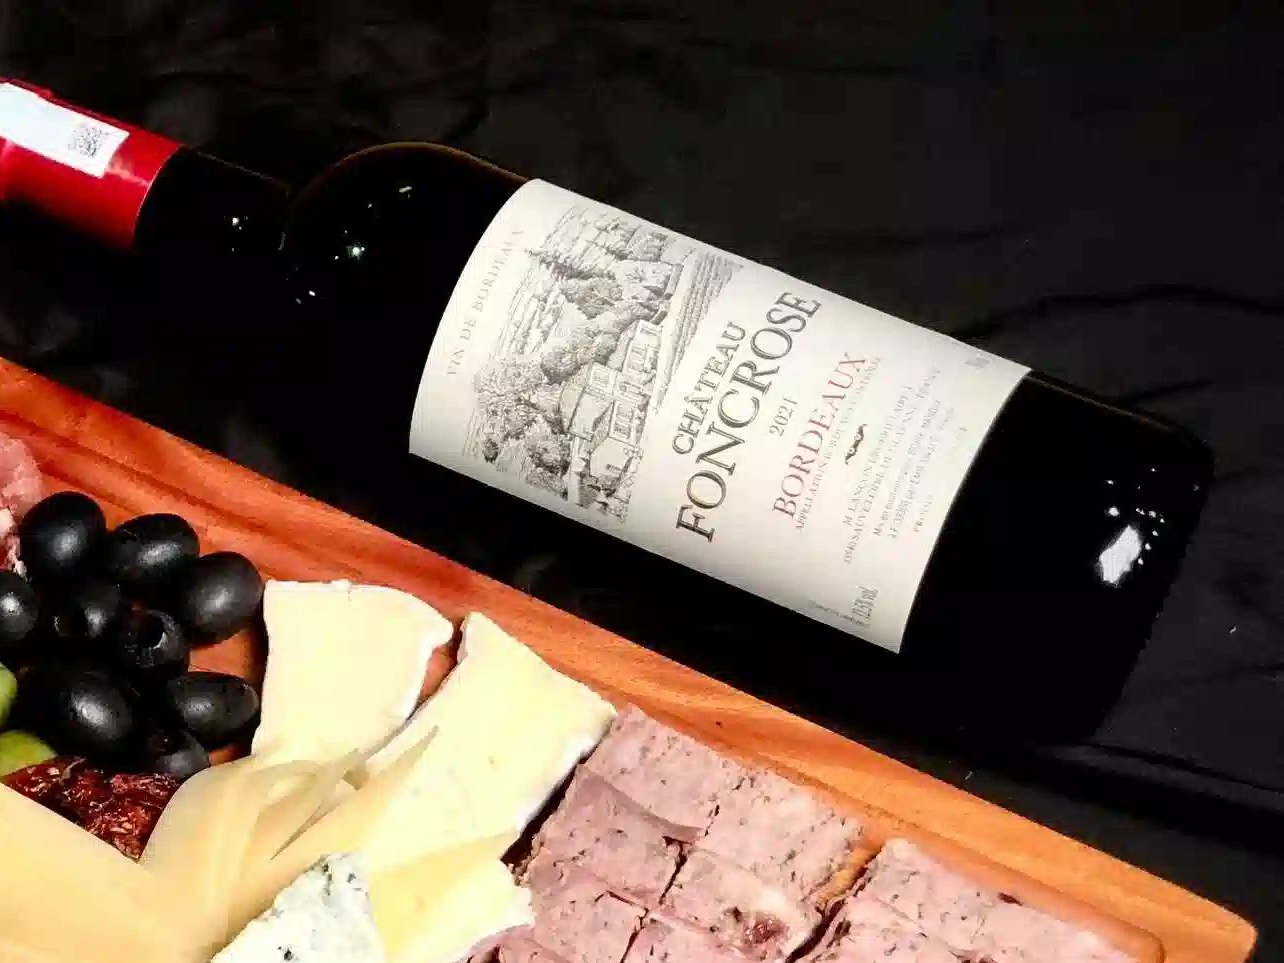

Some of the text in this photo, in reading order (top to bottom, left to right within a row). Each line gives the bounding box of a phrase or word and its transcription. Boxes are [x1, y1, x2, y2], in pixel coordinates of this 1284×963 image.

[671, 321, 747, 455] CHÂTEAU
[676, 291, 823, 543] FONCROSE
[769, 396, 799, 437] 2021
[772, 352, 867, 518] BORDEAUX
